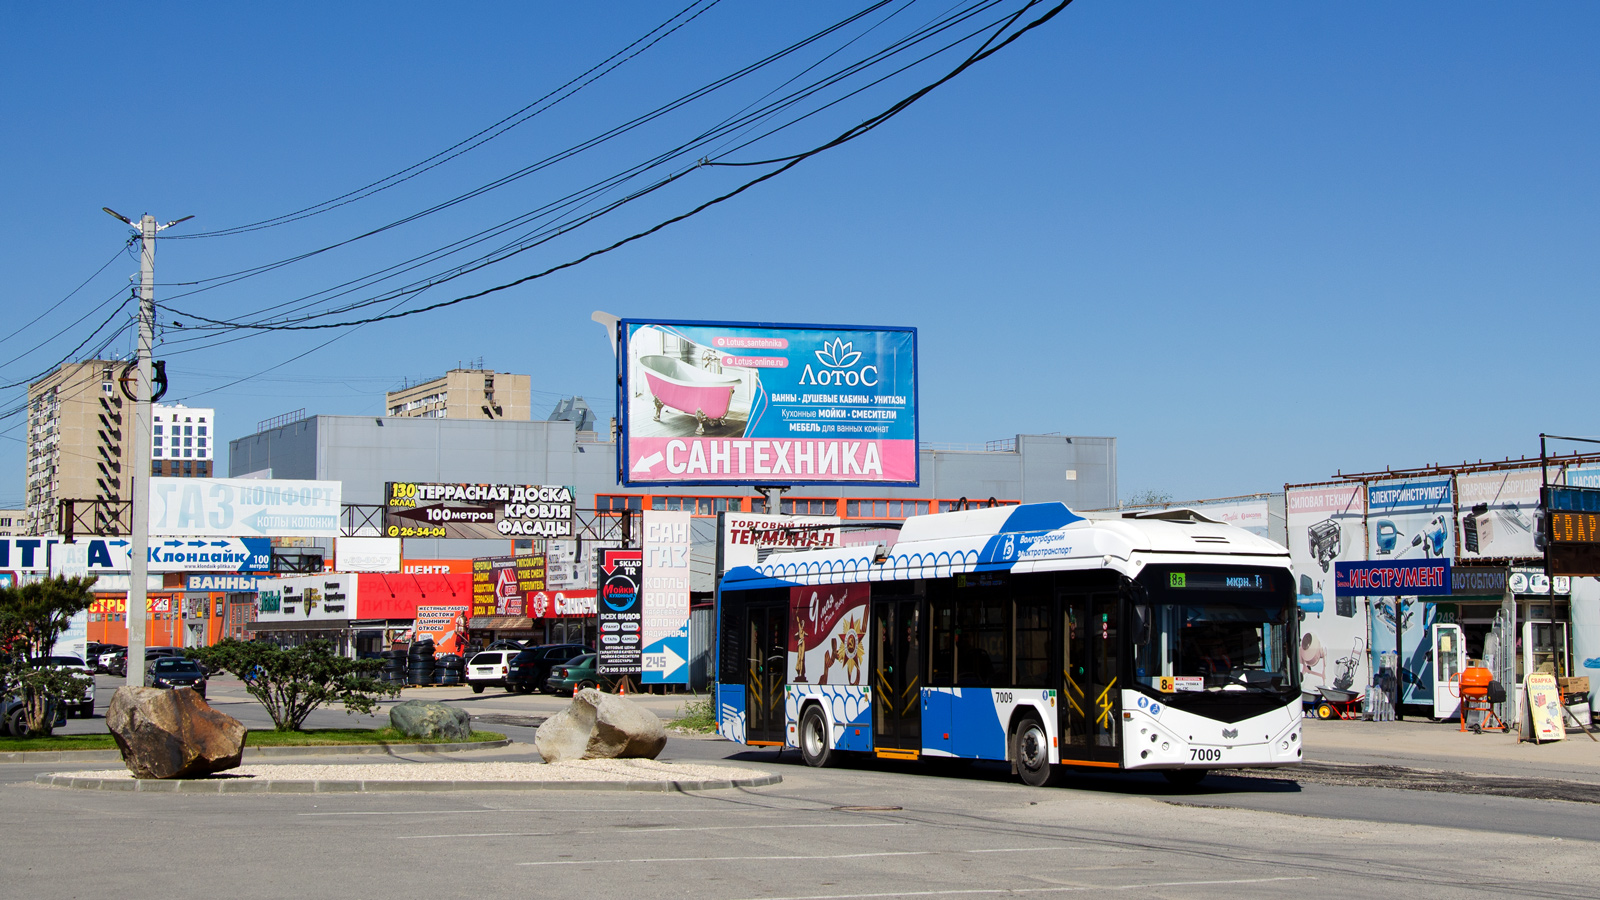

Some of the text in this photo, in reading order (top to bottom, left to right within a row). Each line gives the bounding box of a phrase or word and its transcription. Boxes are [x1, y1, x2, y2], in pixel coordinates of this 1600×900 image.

[726, 338, 782, 348] Lotus_santehnika
[734, 357, 784, 367] Lotus-online.ru
[771, 393, 906, 405] ВАННЫ ДУШЕВЫЕ КАБИНЫ УНИТАЗЫ
[781, 408, 897, 420] Кухонные МОЙКИ СМЕСИТЕЛИ
[789, 423, 889, 434] МЕБЕЛЬ для ванных комнат
[665, 439, 883, 476] САНТЕХНИКА
[1573, 475, 1600, 488] НАСОС
[392, 484, 573, 504] 130 ТЕРРАСНАЯ ДОСКА
[1371, 486, 1448, 504] ЭЛЕКТРОИНСТРУМЕНТ
[1461, 482, 1501, 498] СВАРОЧНОЕ
[156, 483, 334, 530] ГАЗ КОМФОРТ
[389, 499, 416, 508] СКЛАД
[1290, 492, 1359, 509] СИЛОВАЯ ТЕХНИКА
[503, 503, 571, 519] КРОВЛЯ
[257, 516, 335, 530] КОТЛЫ КОЛОНКИ
[496, 520, 571, 538] ФАСАДЫ
[400, 527, 446, 538] 26-54-04
[647, 523, 688, 544] САН
[1020, 532, 1066, 545] Волгоградский
[147, 547, 247, 563] Клондайк
[647, 545, 688, 568] ГАЗ
[1017, 547, 1073, 559] Электротранспорт
[253, 555, 270, 565] 100
[625, 567, 636, 576] TR
[1349, 566, 1445, 588] ИНСТРУМЕНТ
[188, 577, 256, 590] ВАННЫ
[645, 577, 688, 590] КОТЛЫ
[1451, 573, 1506, 590] МОТОБЛОКИ
[554, 592, 599, 616] Сантех
[645, 592, 688, 609] ВОДО
[617, 613, 641, 622] ВИДОВ
[645, 618, 688, 628] КОЛОНКИ
[1437, 611, 1456, 624] 248
[645, 630, 688, 638] РАДИАТОРЫ
[646, 656, 667, 668] 245
[1161, 679, 1174, 690] 8а
[995, 692, 1013, 704] 7009
[1189, 748, 1222, 762] 7009
